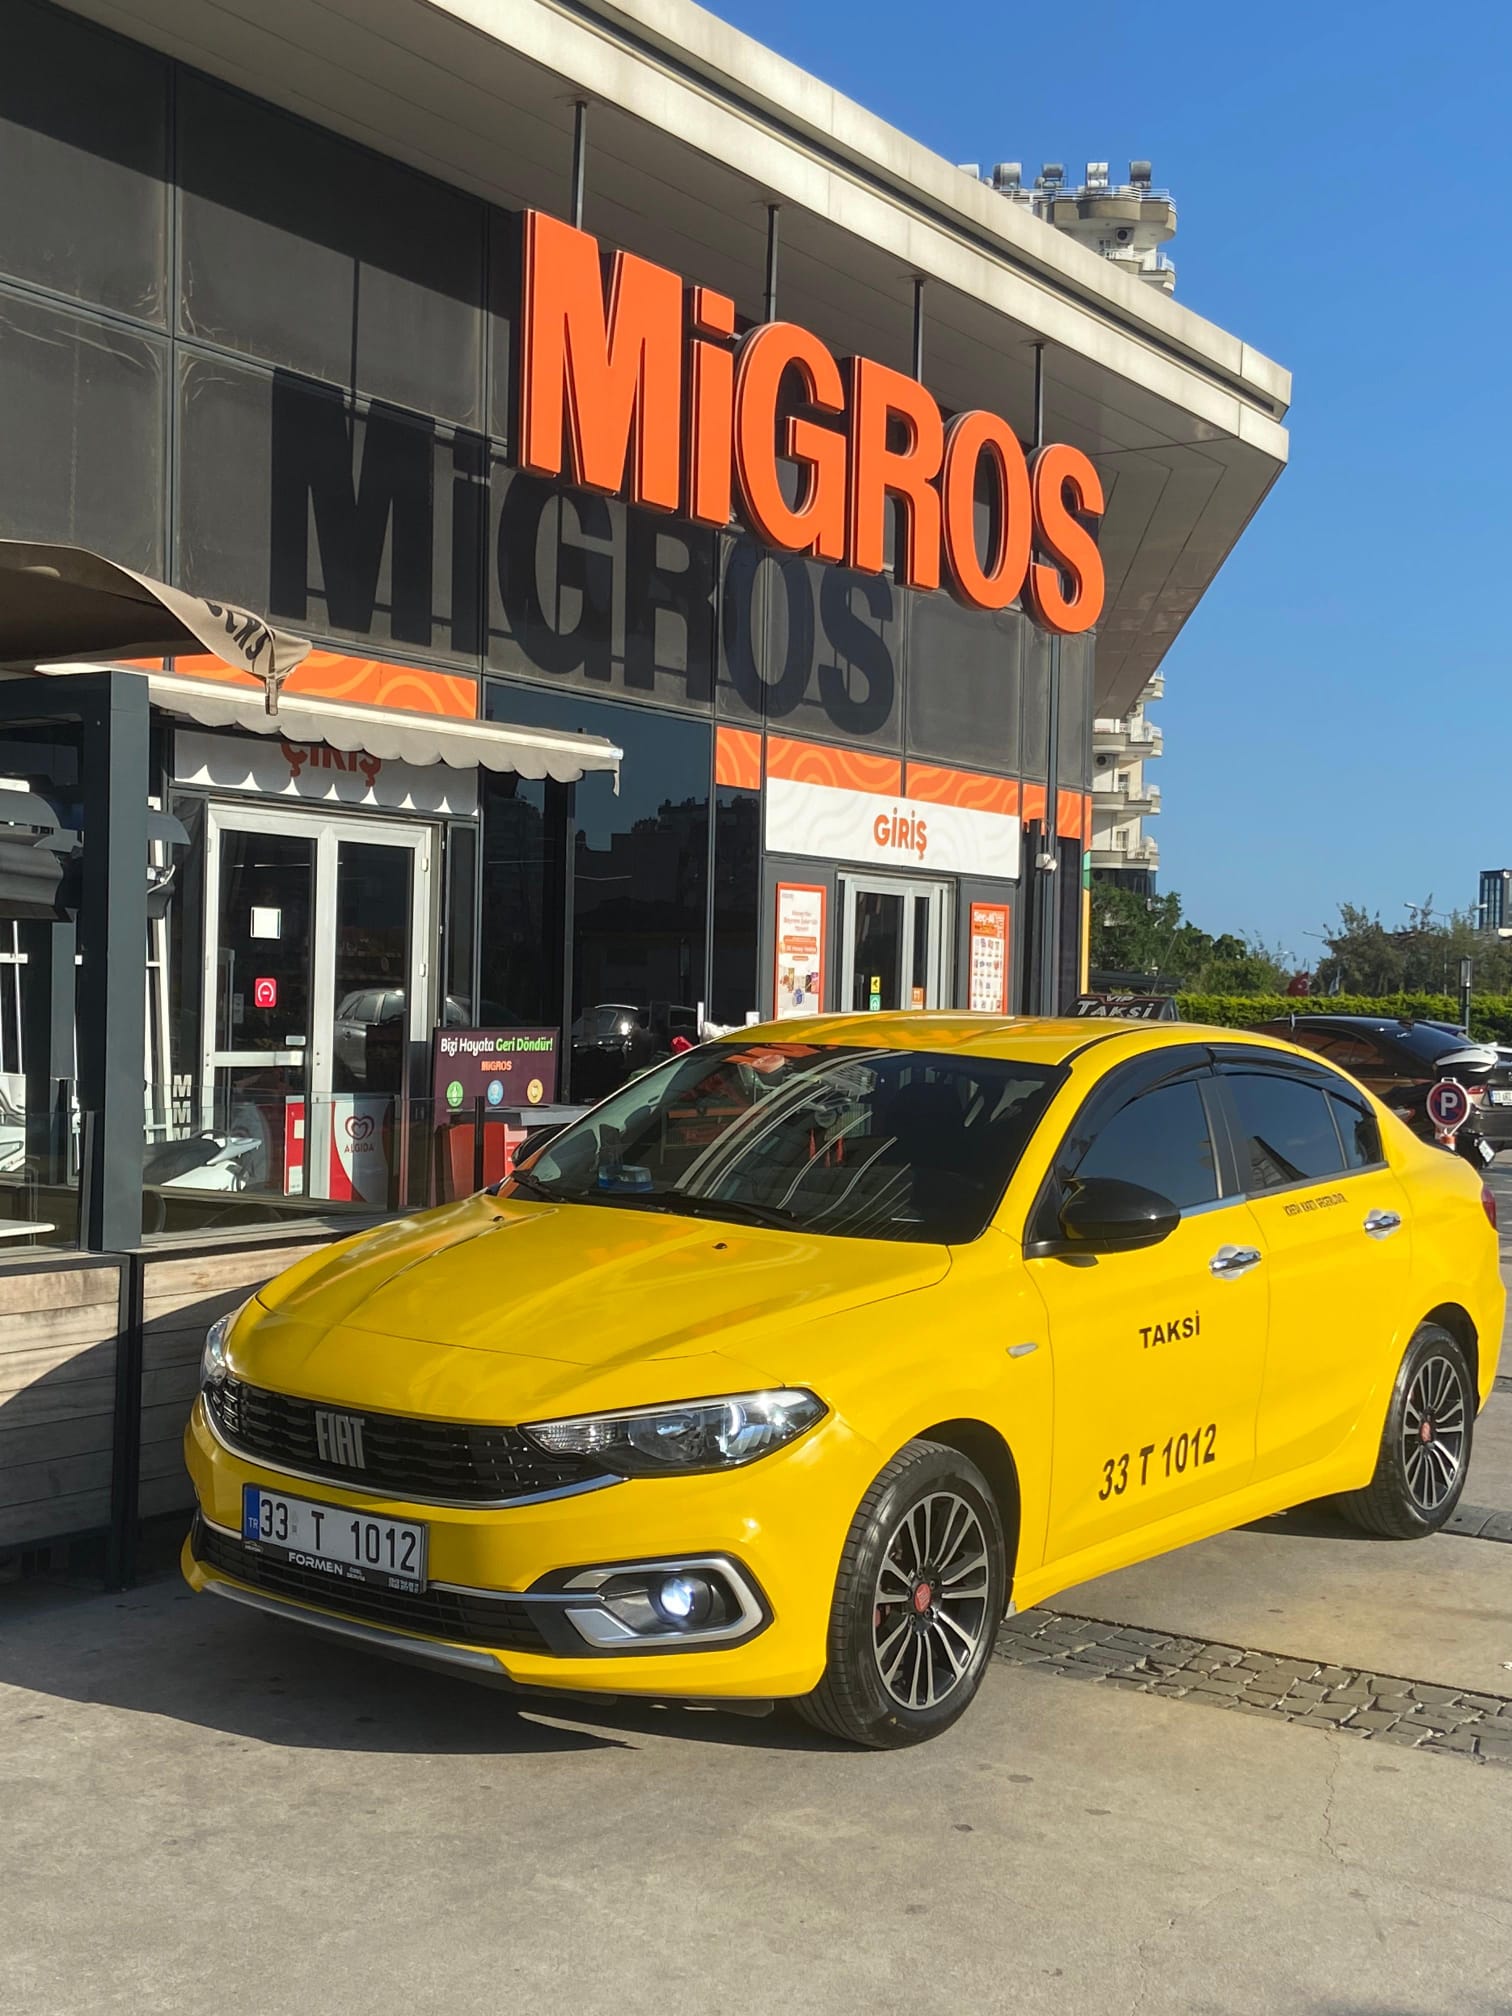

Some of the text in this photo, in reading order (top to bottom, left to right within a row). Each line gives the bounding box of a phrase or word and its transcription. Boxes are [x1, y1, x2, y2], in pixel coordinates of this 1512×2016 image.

[873, 807, 927, 861] GİRİŞ
[440, 1037, 553, 1057] Bizi Hayata Geri Döndür!
[1440, 1091, 1458, 1117] P
[344, 1143, 376, 1154] ALGIDA
[1139, 1310, 1201, 1349] TAKSİ
[315, 1410, 367, 1470] FIAT
[1098, 1422, 1217, 1501] 33 T 1012
[248, 1516, 259, 1530] TR
[260, 1498, 417, 1573] 33 T 1012
[288, 1551, 344, 1576] FORMEN
